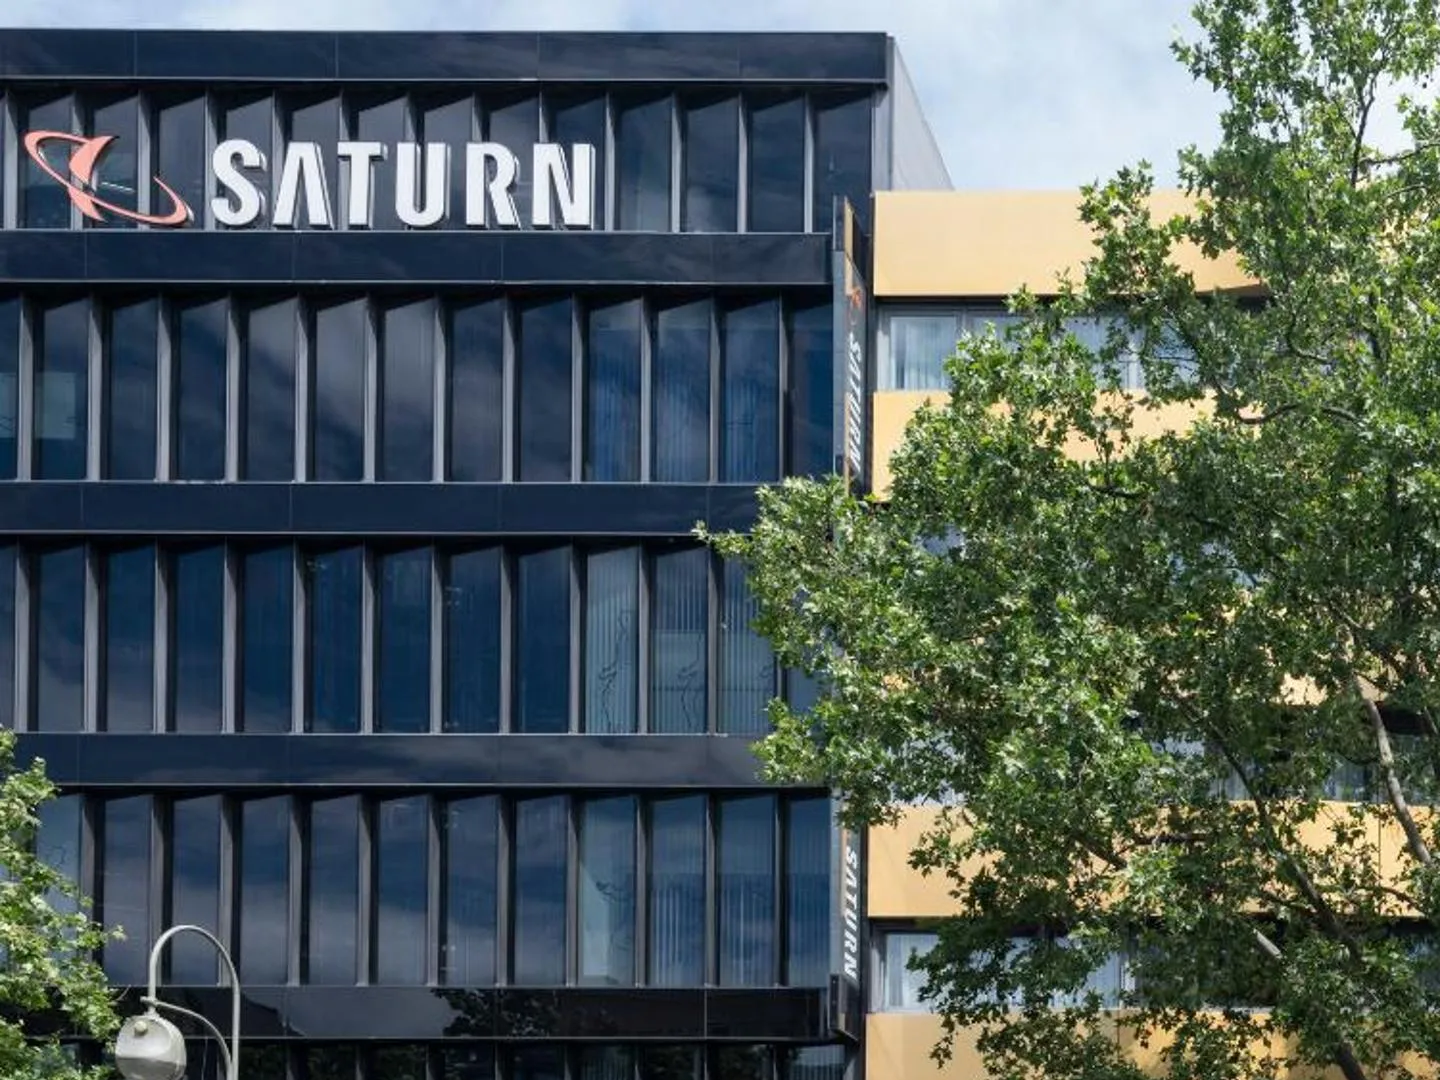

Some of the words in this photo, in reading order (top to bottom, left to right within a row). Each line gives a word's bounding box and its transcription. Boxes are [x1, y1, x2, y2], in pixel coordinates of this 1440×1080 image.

[210, 139, 596, 229] SATURN
[848, 331, 863, 472] SATURN
[842, 845, 859, 981] SATURN
